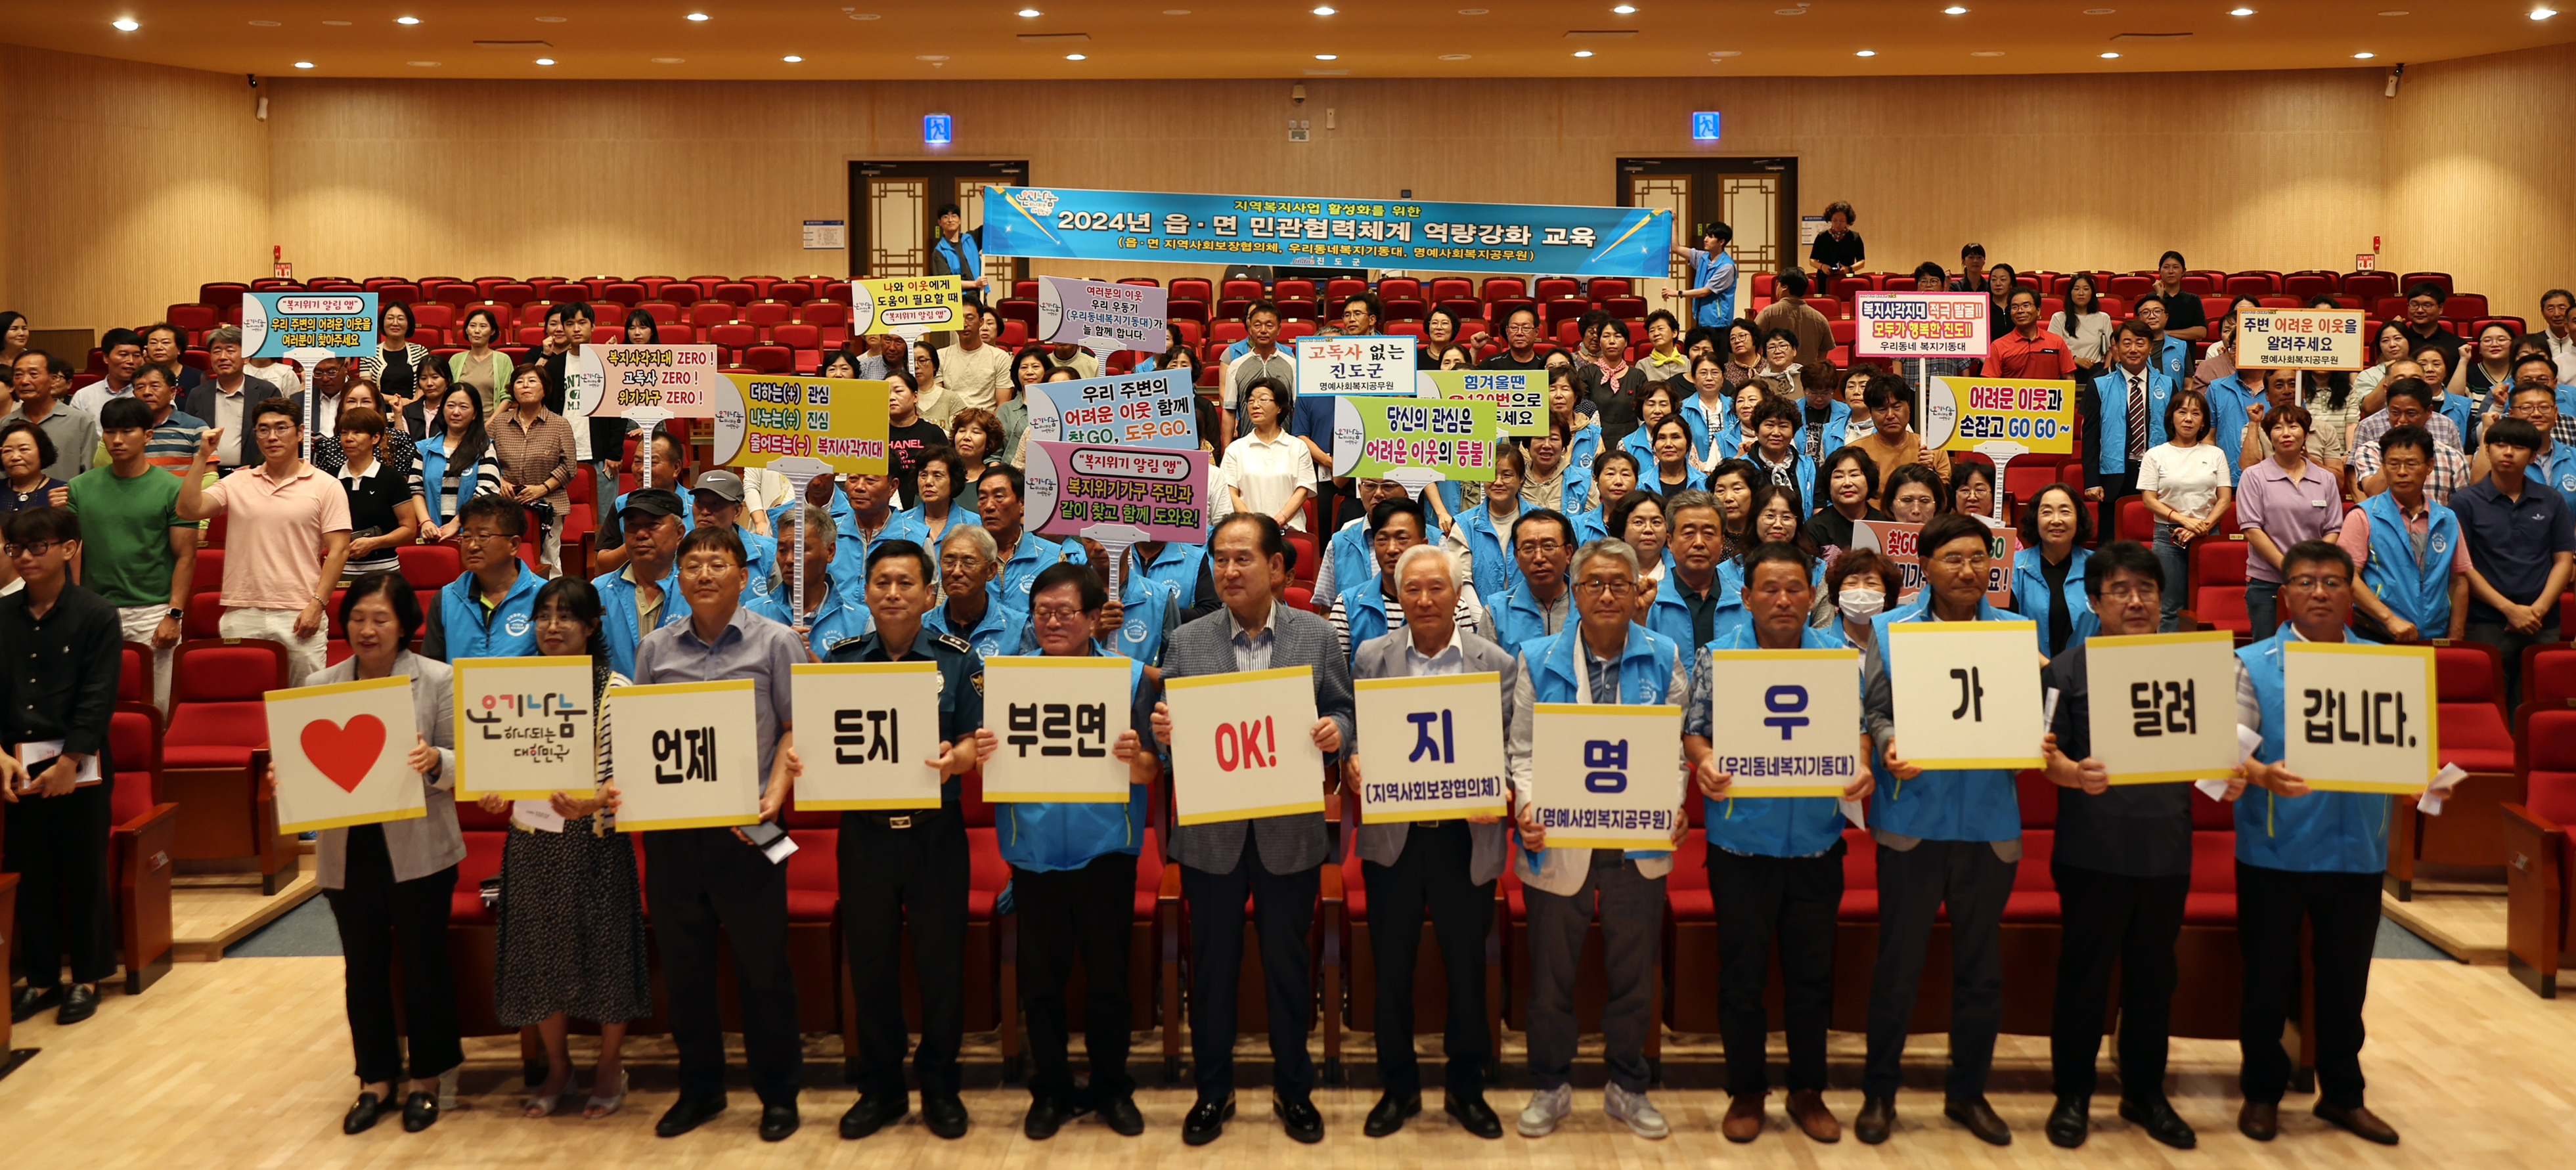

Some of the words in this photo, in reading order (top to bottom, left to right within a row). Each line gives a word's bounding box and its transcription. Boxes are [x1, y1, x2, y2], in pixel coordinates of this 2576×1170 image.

[1234, 201, 1320, 215] 지역복지사업
[1328, 202, 1385, 217] 활성화를
[1392, 205, 1421, 217] 위한
[1057, 210, 1151, 233] 2024년
[1251, 215, 1411, 242] 민관협력체계
[1423, 222, 1532, 246] 역량강화
[1542, 226, 1597, 248] 교육
[883, 282, 904, 293] 나와
[908, 280, 950, 292] 이웃에게
[1086, 286, 1121, 299] 여러분의
[1125, 290, 1143, 302] 이웃
[322, 300, 342, 311] 알림
[877, 295, 908, 307] 도움이
[913, 293, 944, 305] 필요할
[948, 293, 958, 303] 때
[1091, 299, 1108, 311] 우리
[1112, 301, 1138, 314] 우동기
[918, 311, 933, 320] 알림
[1862, 301, 1926, 319] 복지사각지대
[1928, 301, 1952, 319] 적극
[271, 318, 288, 332] 우리
[290, 318, 316, 331] 주변의
[318, 318, 344, 331] 어려운
[346, 318, 372, 332] 이웃을
[1083, 324, 1092, 336] 늘
[1096, 326, 1113, 337] 함께
[1117, 328, 1145, 341] 합니다.
[1873, 320, 1907, 338] 모두가
[1908, 320, 1942, 338] 행복한
[2244, 318, 2269, 332] 주변
[2275, 318, 2313, 333] 어려운
[2319, 318, 2357, 334] 이웃을
[282, 334, 315, 347] 여러분이
[317, 334, 360, 347] 찾아주세요
[1880, 341, 1917, 352] 우리동네
[1920, 341, 1966, 353] 복지기동대
[2267, 336, 2332, 351] 알려주세요
[608, 349, 672, 366] 복지사각지대
[1308, 343, 1362, 360] 고독사
[1369, 344, 1405, 360] 없는
[2261, 355, 2338, 364] 명예사회복지공무원
[622, 370, 657, 386] 고독사
[1329, 362, 1384, 379] 진도군
[1082, 384, 1114, 402] 우리
[1120, 378, 1168, 399] 주변의
[1319, 381, 1394, 391] 명예사회복지공무원
[1463, 375, 1525, 390] 힘겨울땐
[618, 389, 662, 406] 위기가구
[807, 385, 830, 405] 관심
[1970, 386, 2014, 410] 어려운
[2018, 387, 2062, 412] 이웃과
[807, 410, 830, 431] 진심
[1065, 406, 1113, 426] 어려운
[1120, 402, 1151, 420] 이웃
[1157, 397, 1189, 416] 함께
[1387, 406, 1427, 432] 당신의
[1431, 408, 1474, 433] 관심은
[1959, 414, 2003, 438] 손잡고
[2009, 417, 2030, 438] GO
[2034, 418, 2056, 439] GO
[816, 437, 883, 458] 복지사각지대
[1366, 438, 1407, 464] 어려운
[1411, 439, 1452, 465] 이웃의
[1134, 458, 1159, 473] 알림
[1067, 477, 1147, 500] 복지위기가구
[1151, 483, 1194, 504] 주민과
[1060, 500, 1088, 520] 같이
[1091, 502, 1119, 521] 찾고
[1122, 504, 1150, 524] 함께
[1950, 666, 1984, 722] 가
[466, 693, 588, 739] 온기나눔
[1764, 685, 1810, 741] 우
[2131, 678, 2197, 737] 달려
[2303, 688, 2416, 747] 갑니다.
[504, 726, 556, 743] 하나되는
[834, 708, 899, 764] 든지
[1007, 703, 1106, 758] 부르면
[1407, 709, 1455, 764] 지
[1215, 715, 1277, 772] OK!
[514, 744, 570, 763] 대한민국
[652, 726, 717, 784] 언제
[1584, 739, 1628, 793] 명
